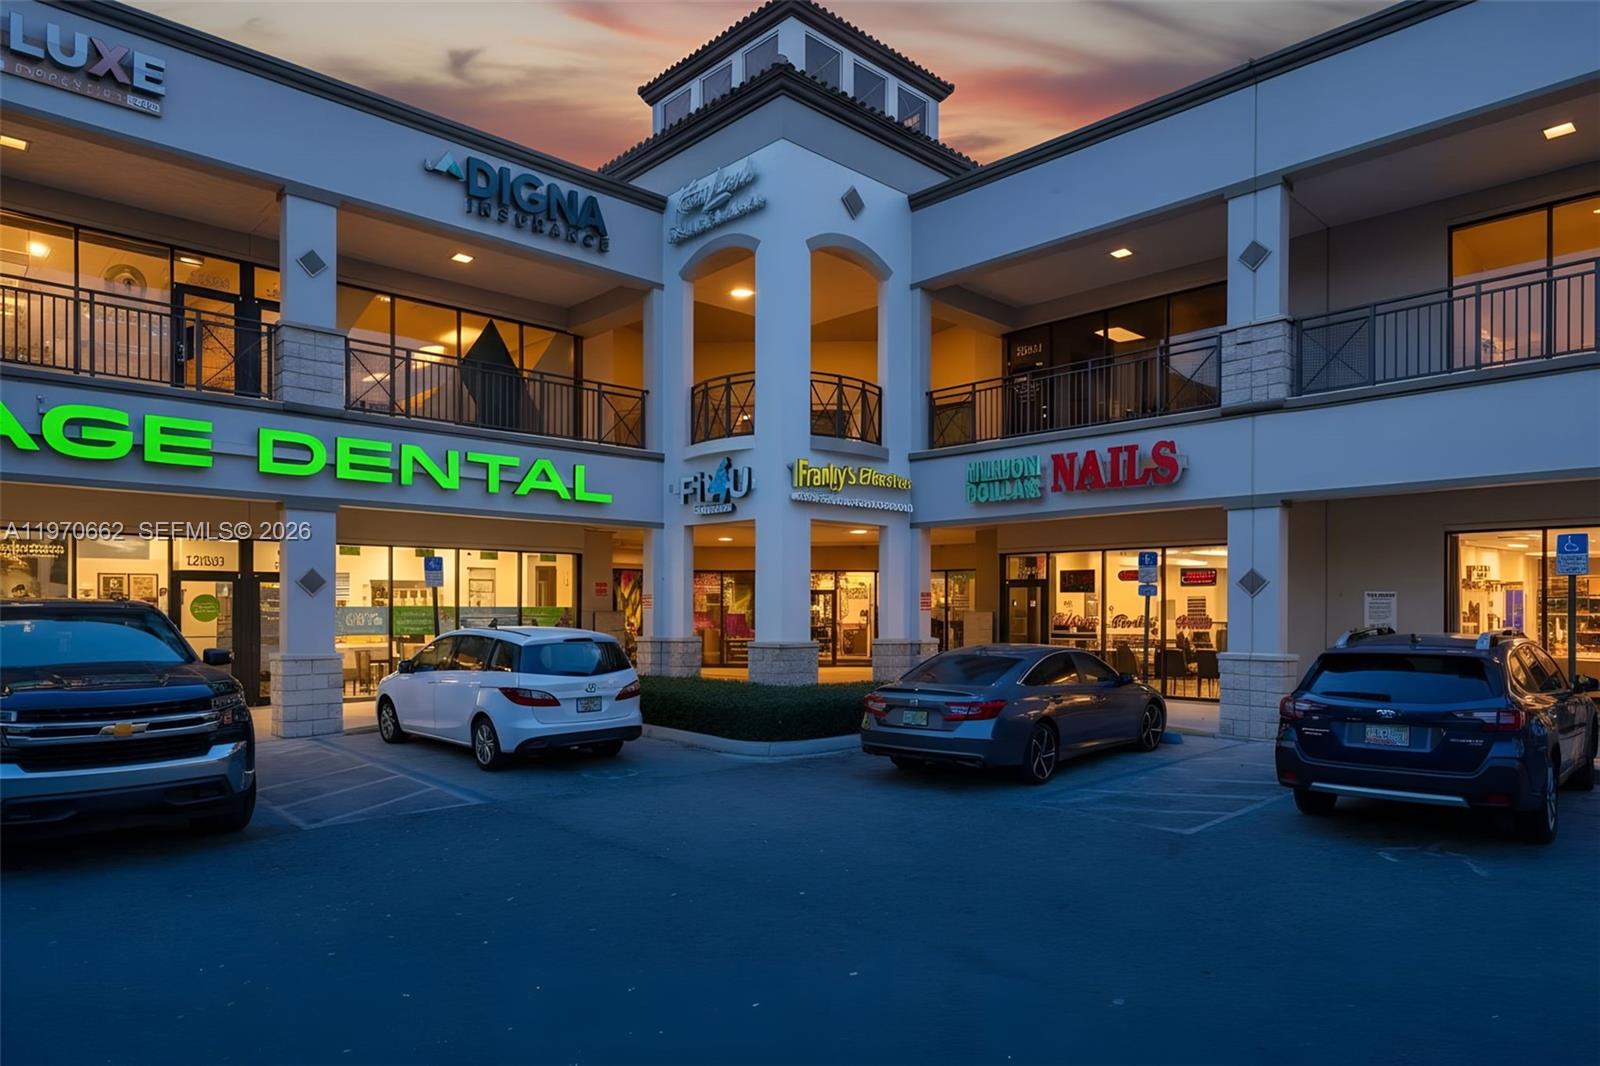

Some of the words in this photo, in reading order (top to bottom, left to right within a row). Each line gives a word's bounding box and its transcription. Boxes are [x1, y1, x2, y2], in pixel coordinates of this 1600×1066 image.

[9, 11, 166, 96] LUXE
[466, 156, 608, 237] DIGNA
[258, 427, 613, 504] DENTAL
[1051, 440, 1179, 493] NAILS
